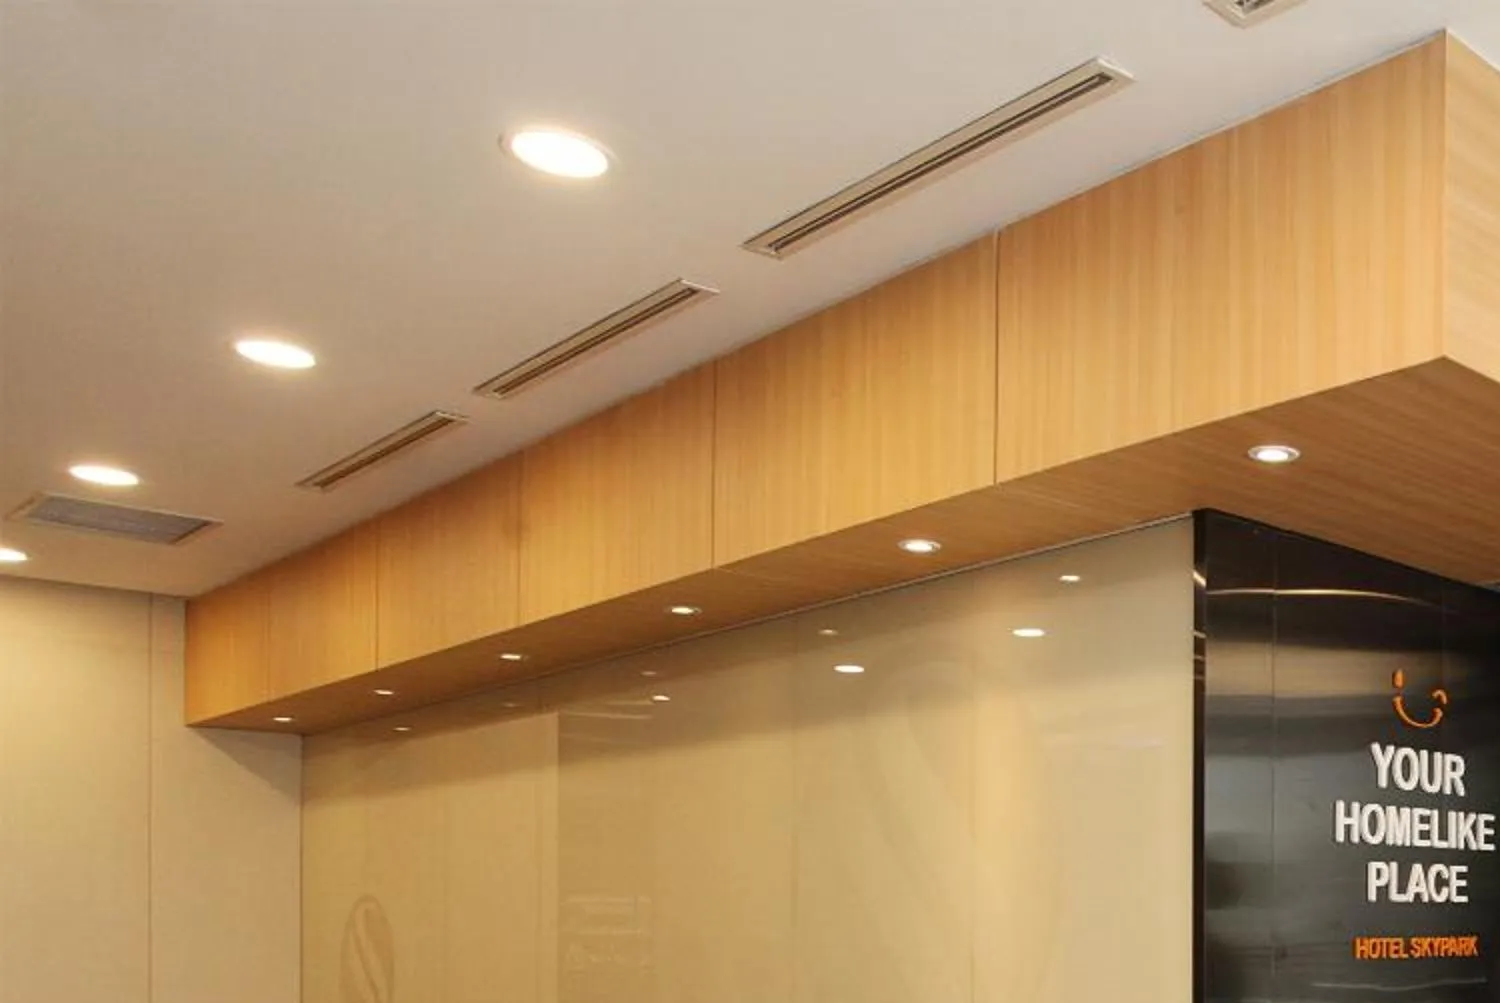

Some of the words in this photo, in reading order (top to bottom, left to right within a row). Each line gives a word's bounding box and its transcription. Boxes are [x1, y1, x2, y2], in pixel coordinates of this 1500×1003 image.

[1370, 742, 1466, 797] YOUR
[1334, 800, 1496, 851] HOMELIKE
[1366, 861, 1469, 903] PLACE
[1355, 937, 1409, 960] HOTEL
[1410, 936, 1478, 957] SKYPARK
